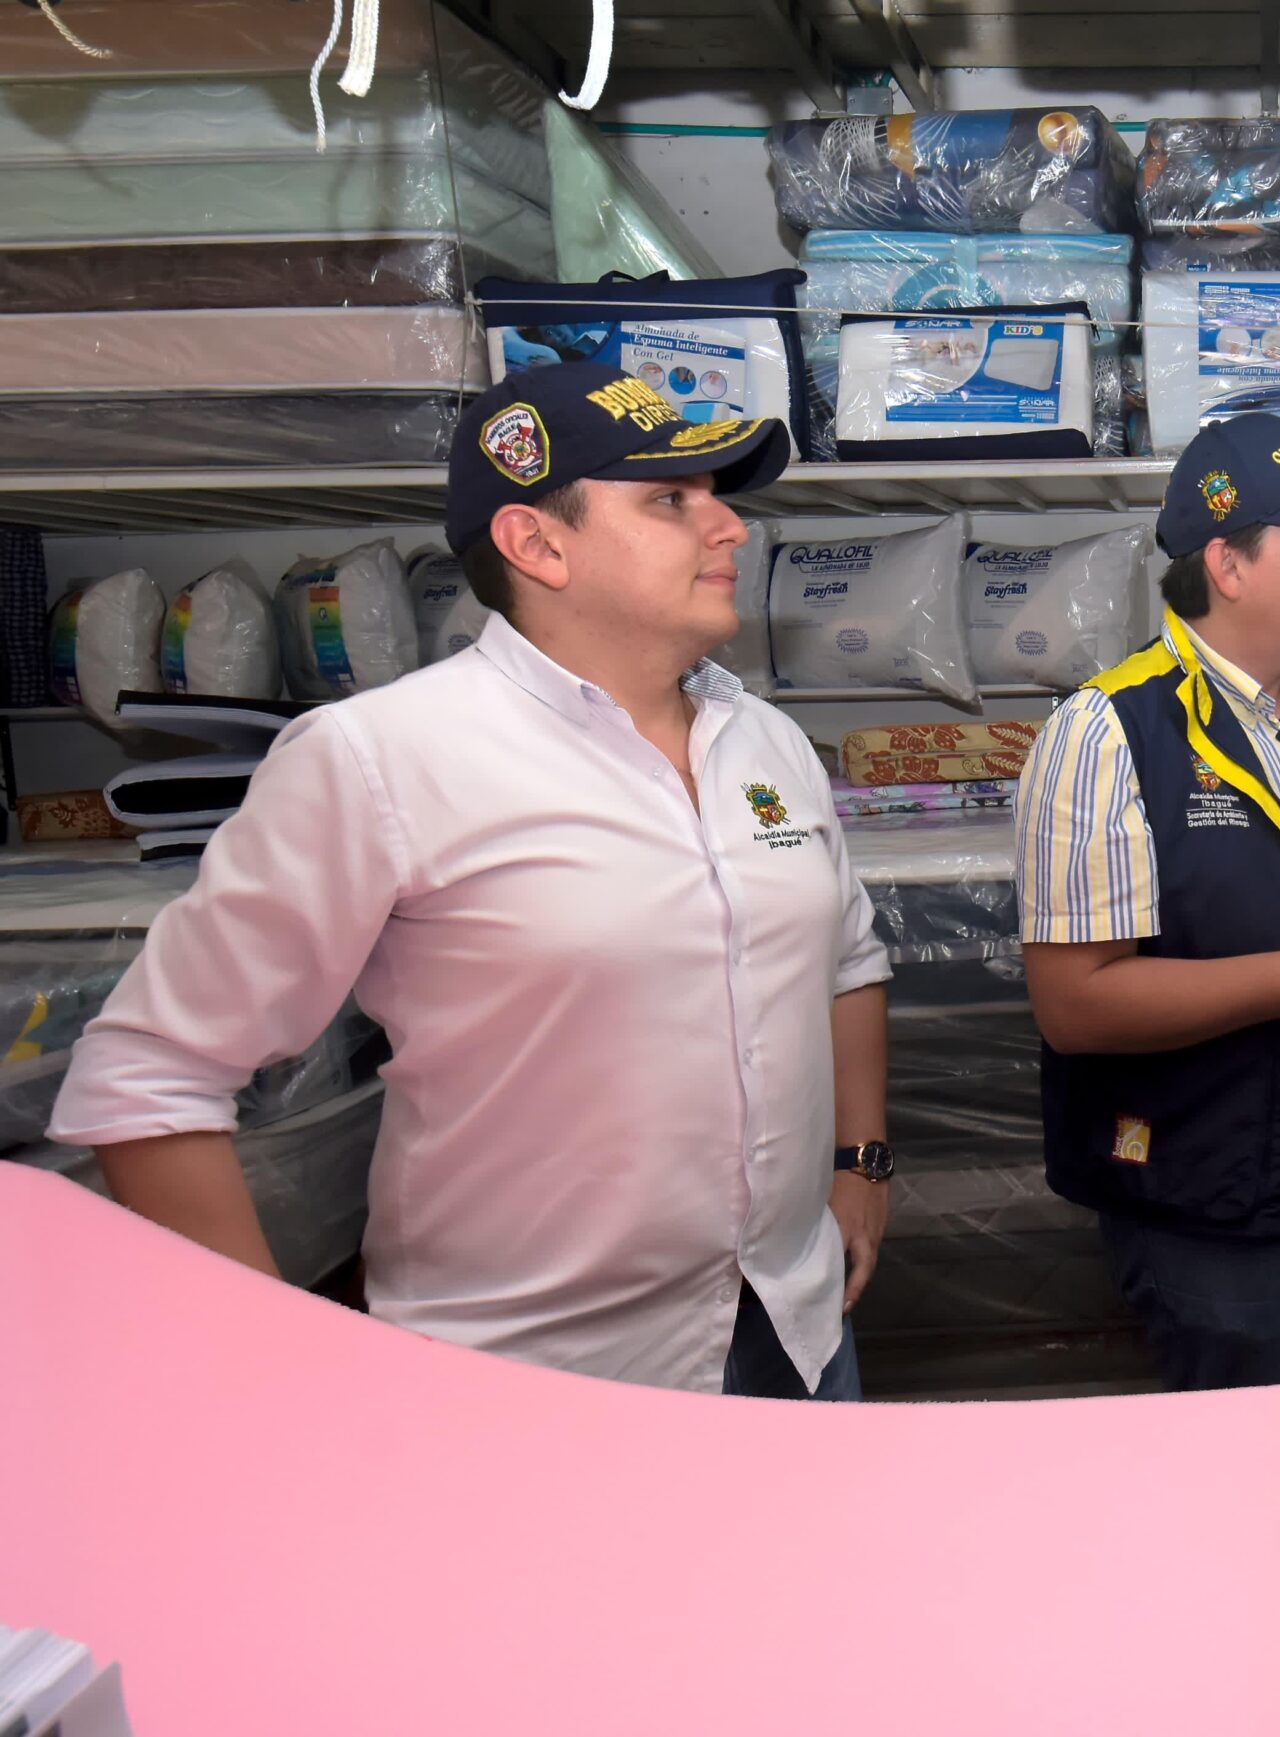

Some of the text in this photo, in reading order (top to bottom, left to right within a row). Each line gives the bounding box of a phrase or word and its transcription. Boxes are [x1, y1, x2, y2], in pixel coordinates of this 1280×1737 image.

[687, 331, 700, 341] de
[633, 334, 729, 357] Espuma Inteligente
[633, 348, 674, 362] Con Gel
[790, 545, 874, 565] QUALLOFIL
[803, 583, 849, 599] Stayfresh
[984, 582, 1028, 599] Stayfresh
[1201, 800, 1232, 809] Ibagué
[1187, 817, 1217, 828] Gestión
[1217, 818, 1228, 826] del
[781, 828, 810, 840] Municipal
[768, 837, 803, 851] Ibagué
